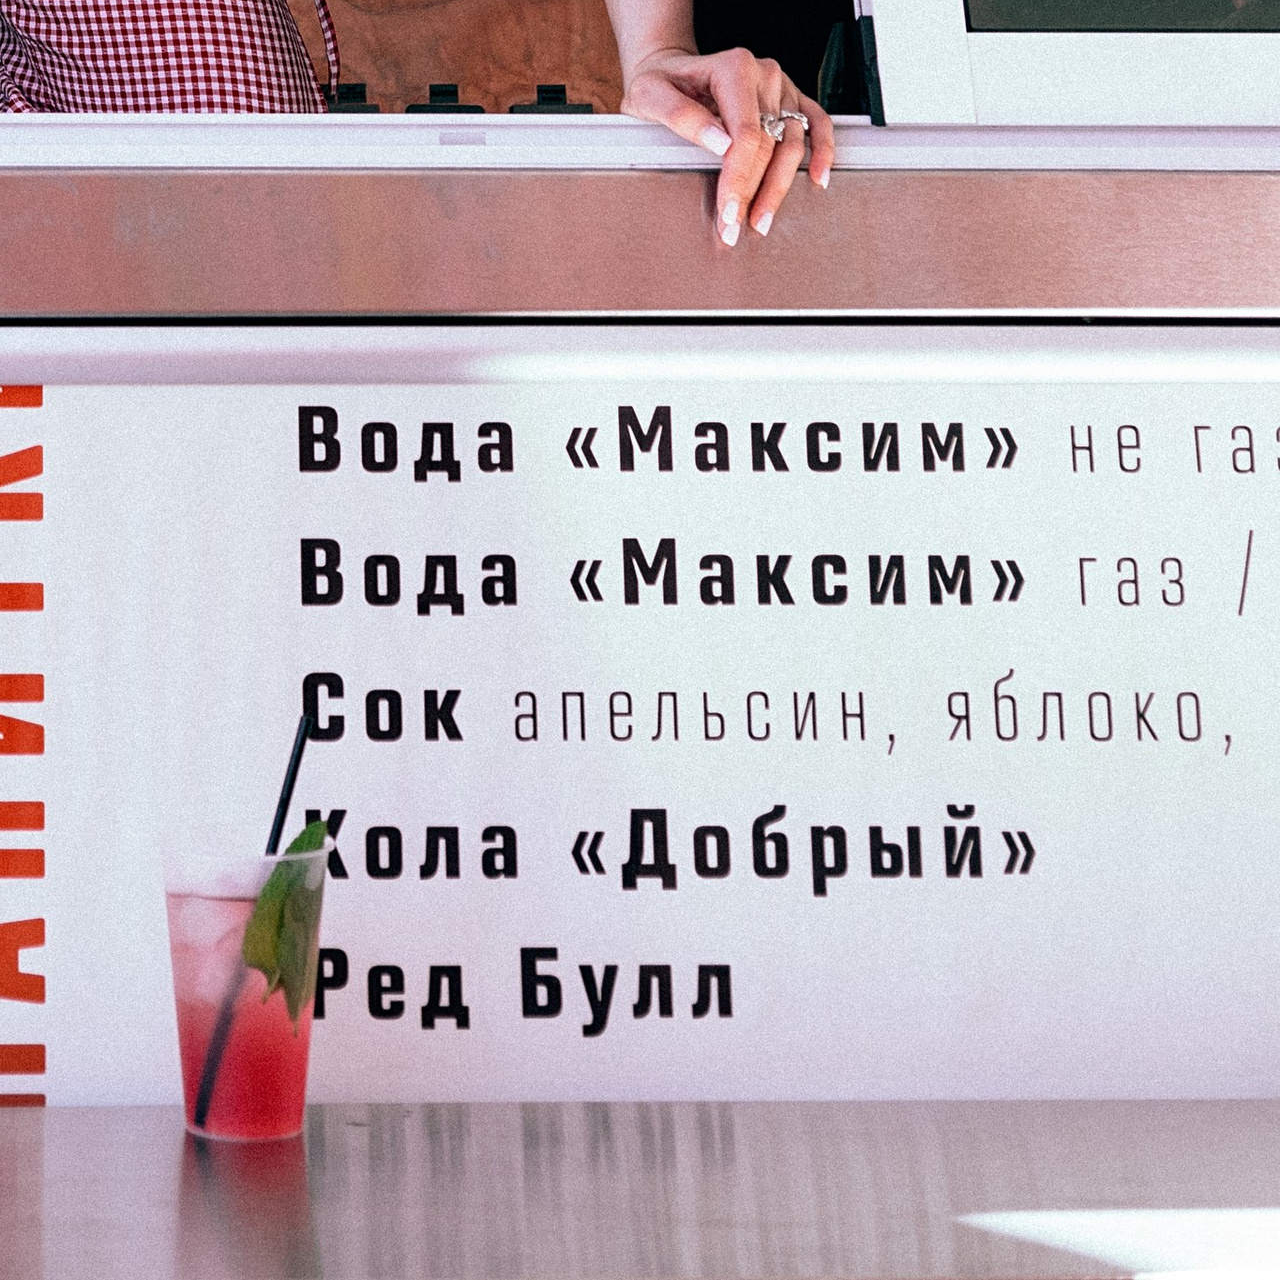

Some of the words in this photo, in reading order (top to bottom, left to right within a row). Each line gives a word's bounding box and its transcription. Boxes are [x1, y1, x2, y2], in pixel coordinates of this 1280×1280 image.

[298, 406, 514, 482] Вода
[565, 406, 1017, 472] «Максим»
[1071, 425, 1141, 473] не
[1193, 425, 1280, 474] га
[300, 538, 517, 616] Вода
[570, 538, 1024, 605] «Максим»
[1078, 556, 1185, 607] газ
[1238, 530, 1253, 616] /
[303, 672, 463, 742] Сок
[513, 691, 896, 755] апельсин,
[947, 669, 1232, 754] яблоко,
[305, 809, 518, 880] Кола
[571, 804, 1035, 897] «Добрый»
[313, 947, 470, 1030] Ред
[520, 946, 733, 1038] Булл
